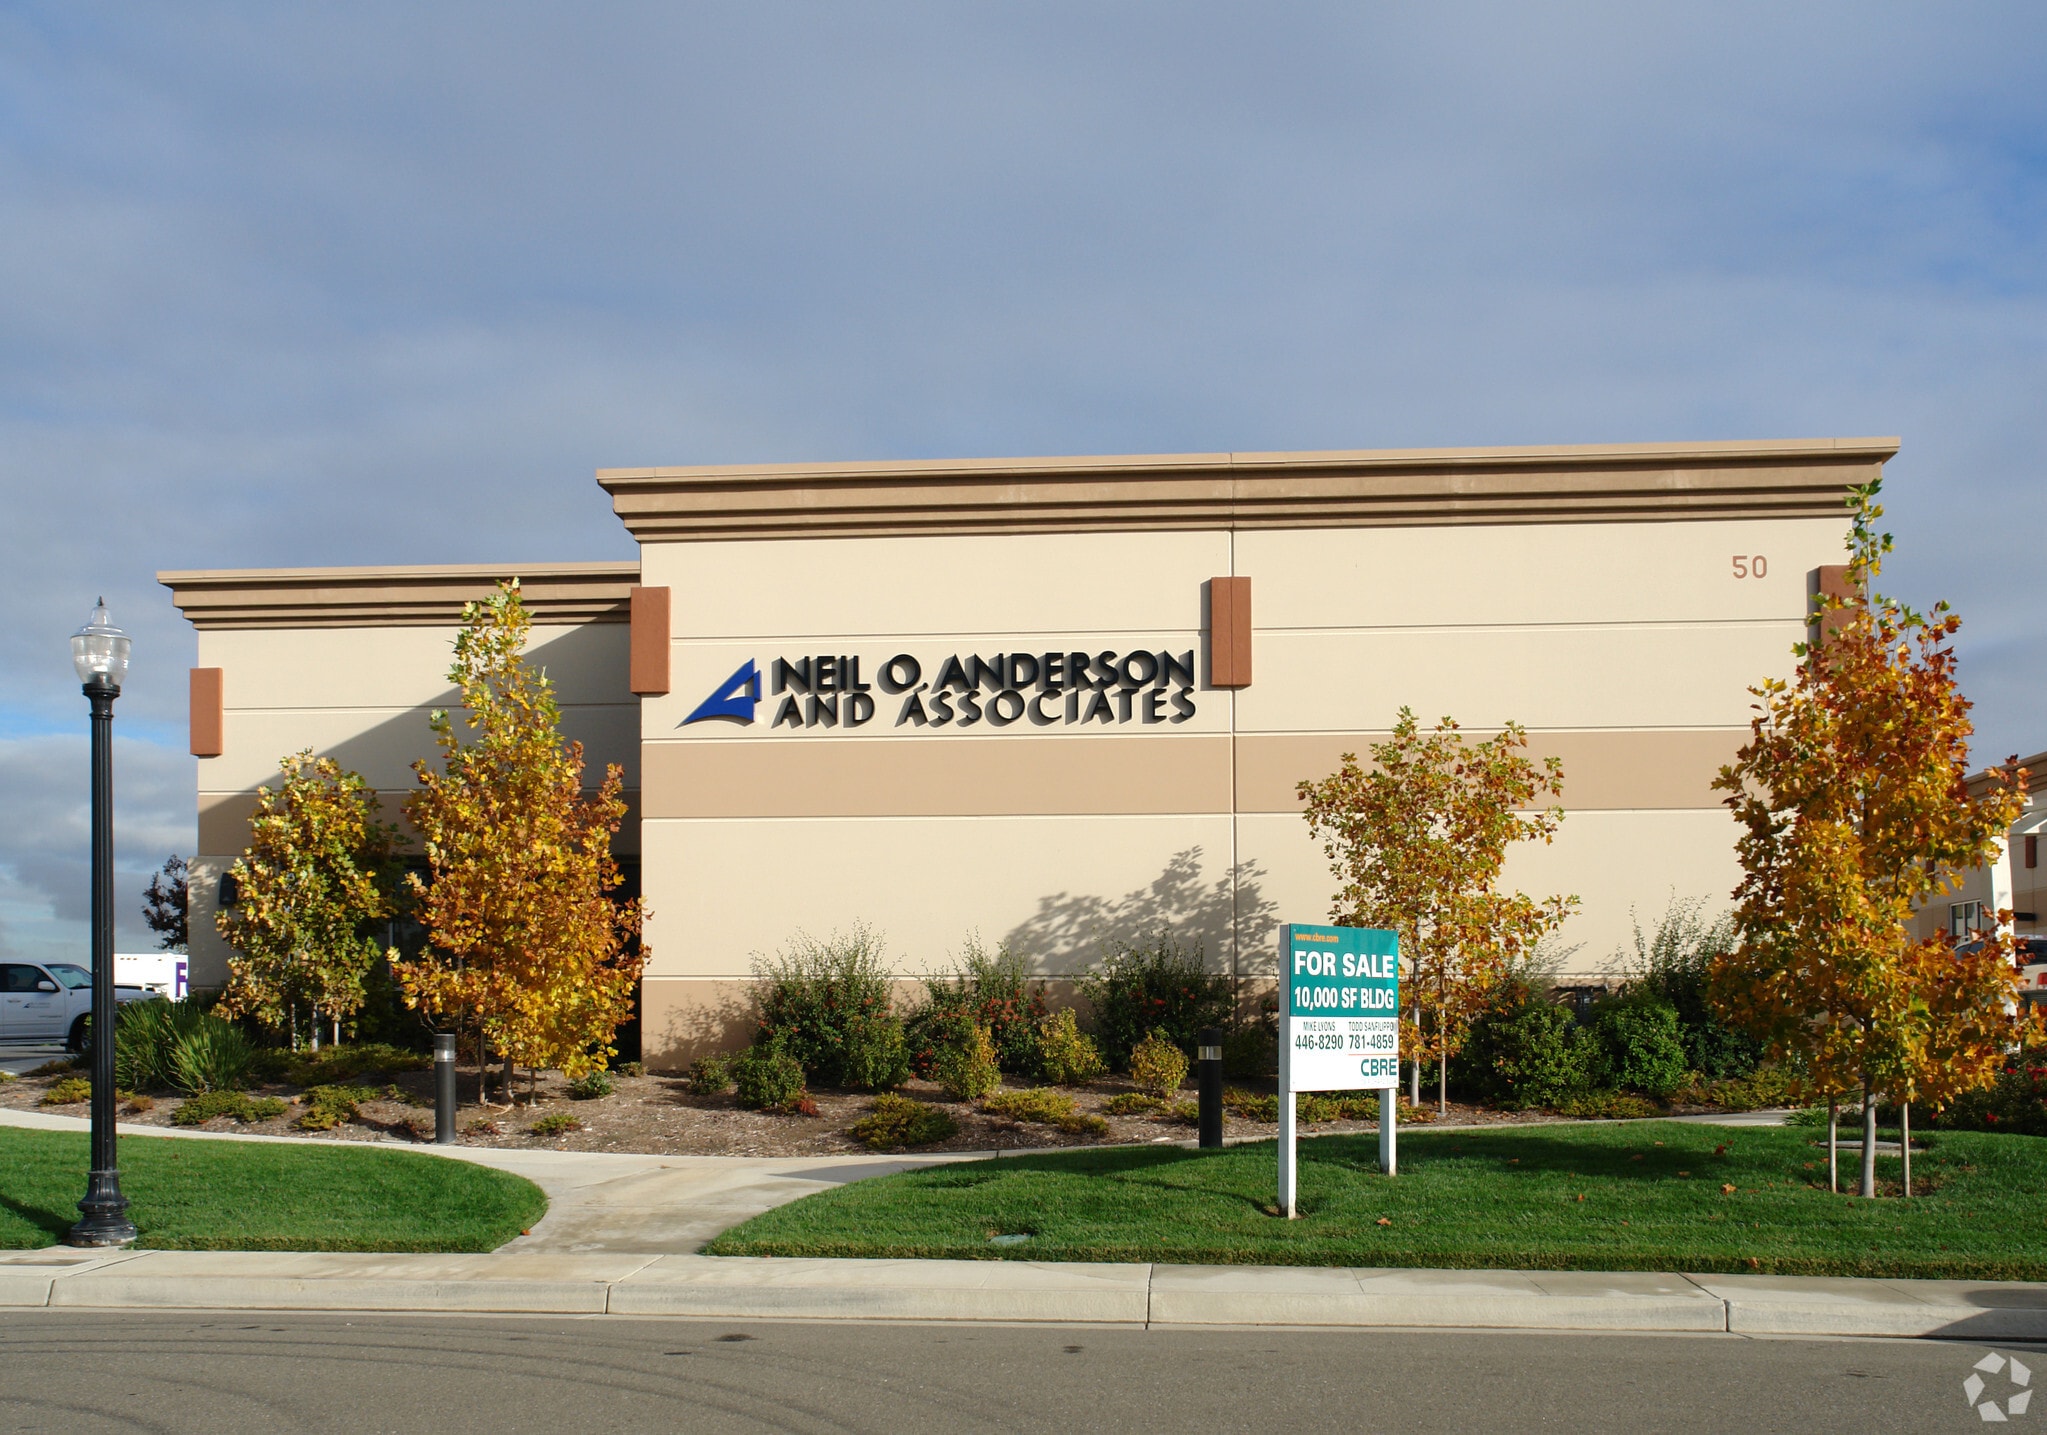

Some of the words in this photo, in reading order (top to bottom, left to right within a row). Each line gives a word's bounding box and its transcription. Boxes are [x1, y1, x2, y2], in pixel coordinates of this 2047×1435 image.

[1732, 555, 1767, 579] 50
[777, 655, 871, 692] NEIL
[884, 653, 928, 691] O.
[938, 649, 1195, 691] ANDERSON
[778, 692, 875, 725] AND
[902, 686, 1197, 725] ASSOCIATES
[1295, 933, 1339, 943] www.cbre.com
[1294, 950, 1337, 976] FOR
[1342, 953, 1394, 978] SALE
[1294, 986, 1339, 1011] 10,000
[1341, 987, 1358, 1009] SF
[1360, 988, 1394, 1010] BLDG
[1303, 1021, 1317, 1032] MIKE
[1318, 1021, 1336, 1032] LYONS
[1348, 1021, 1363, 1032] TODD
[1360, 1058, 1398, 1077] CBRE
